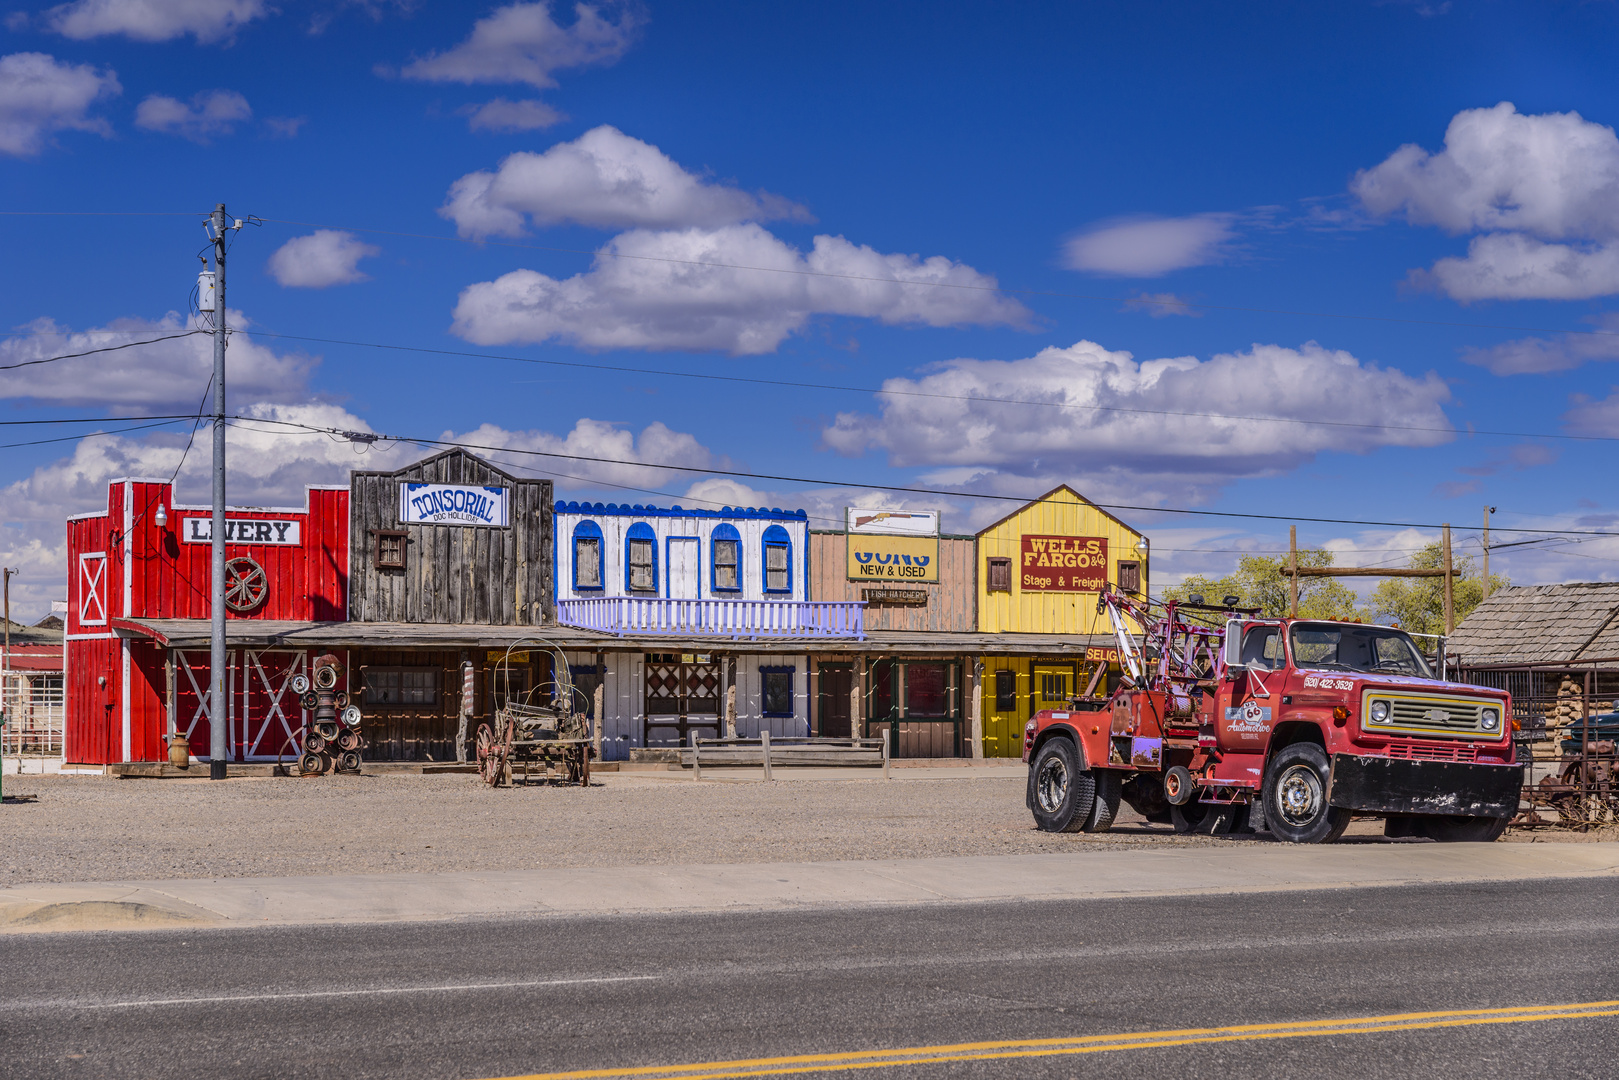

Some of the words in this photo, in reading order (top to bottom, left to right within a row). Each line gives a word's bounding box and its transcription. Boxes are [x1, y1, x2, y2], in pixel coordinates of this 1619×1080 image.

[411, 489, 495, 523] TONSORIAL
[433, 513, 447, 522] DOC
[448, 511, 480, 523] HOLLIDAY
[860, 564, 884, 576] NEW
[887, 565, 895, 576] &
[898, 566, 926, 577] USED
[1023, 574, 1052, 589] Stage
[1058, 576, 1065, 587] &
[1072, 576, 1105, 590] Freight
[871, 590, 887, 598] FISH
[1247, 707, 1261, 718] 66
[1226, 719, 1271, 732] Automotive
